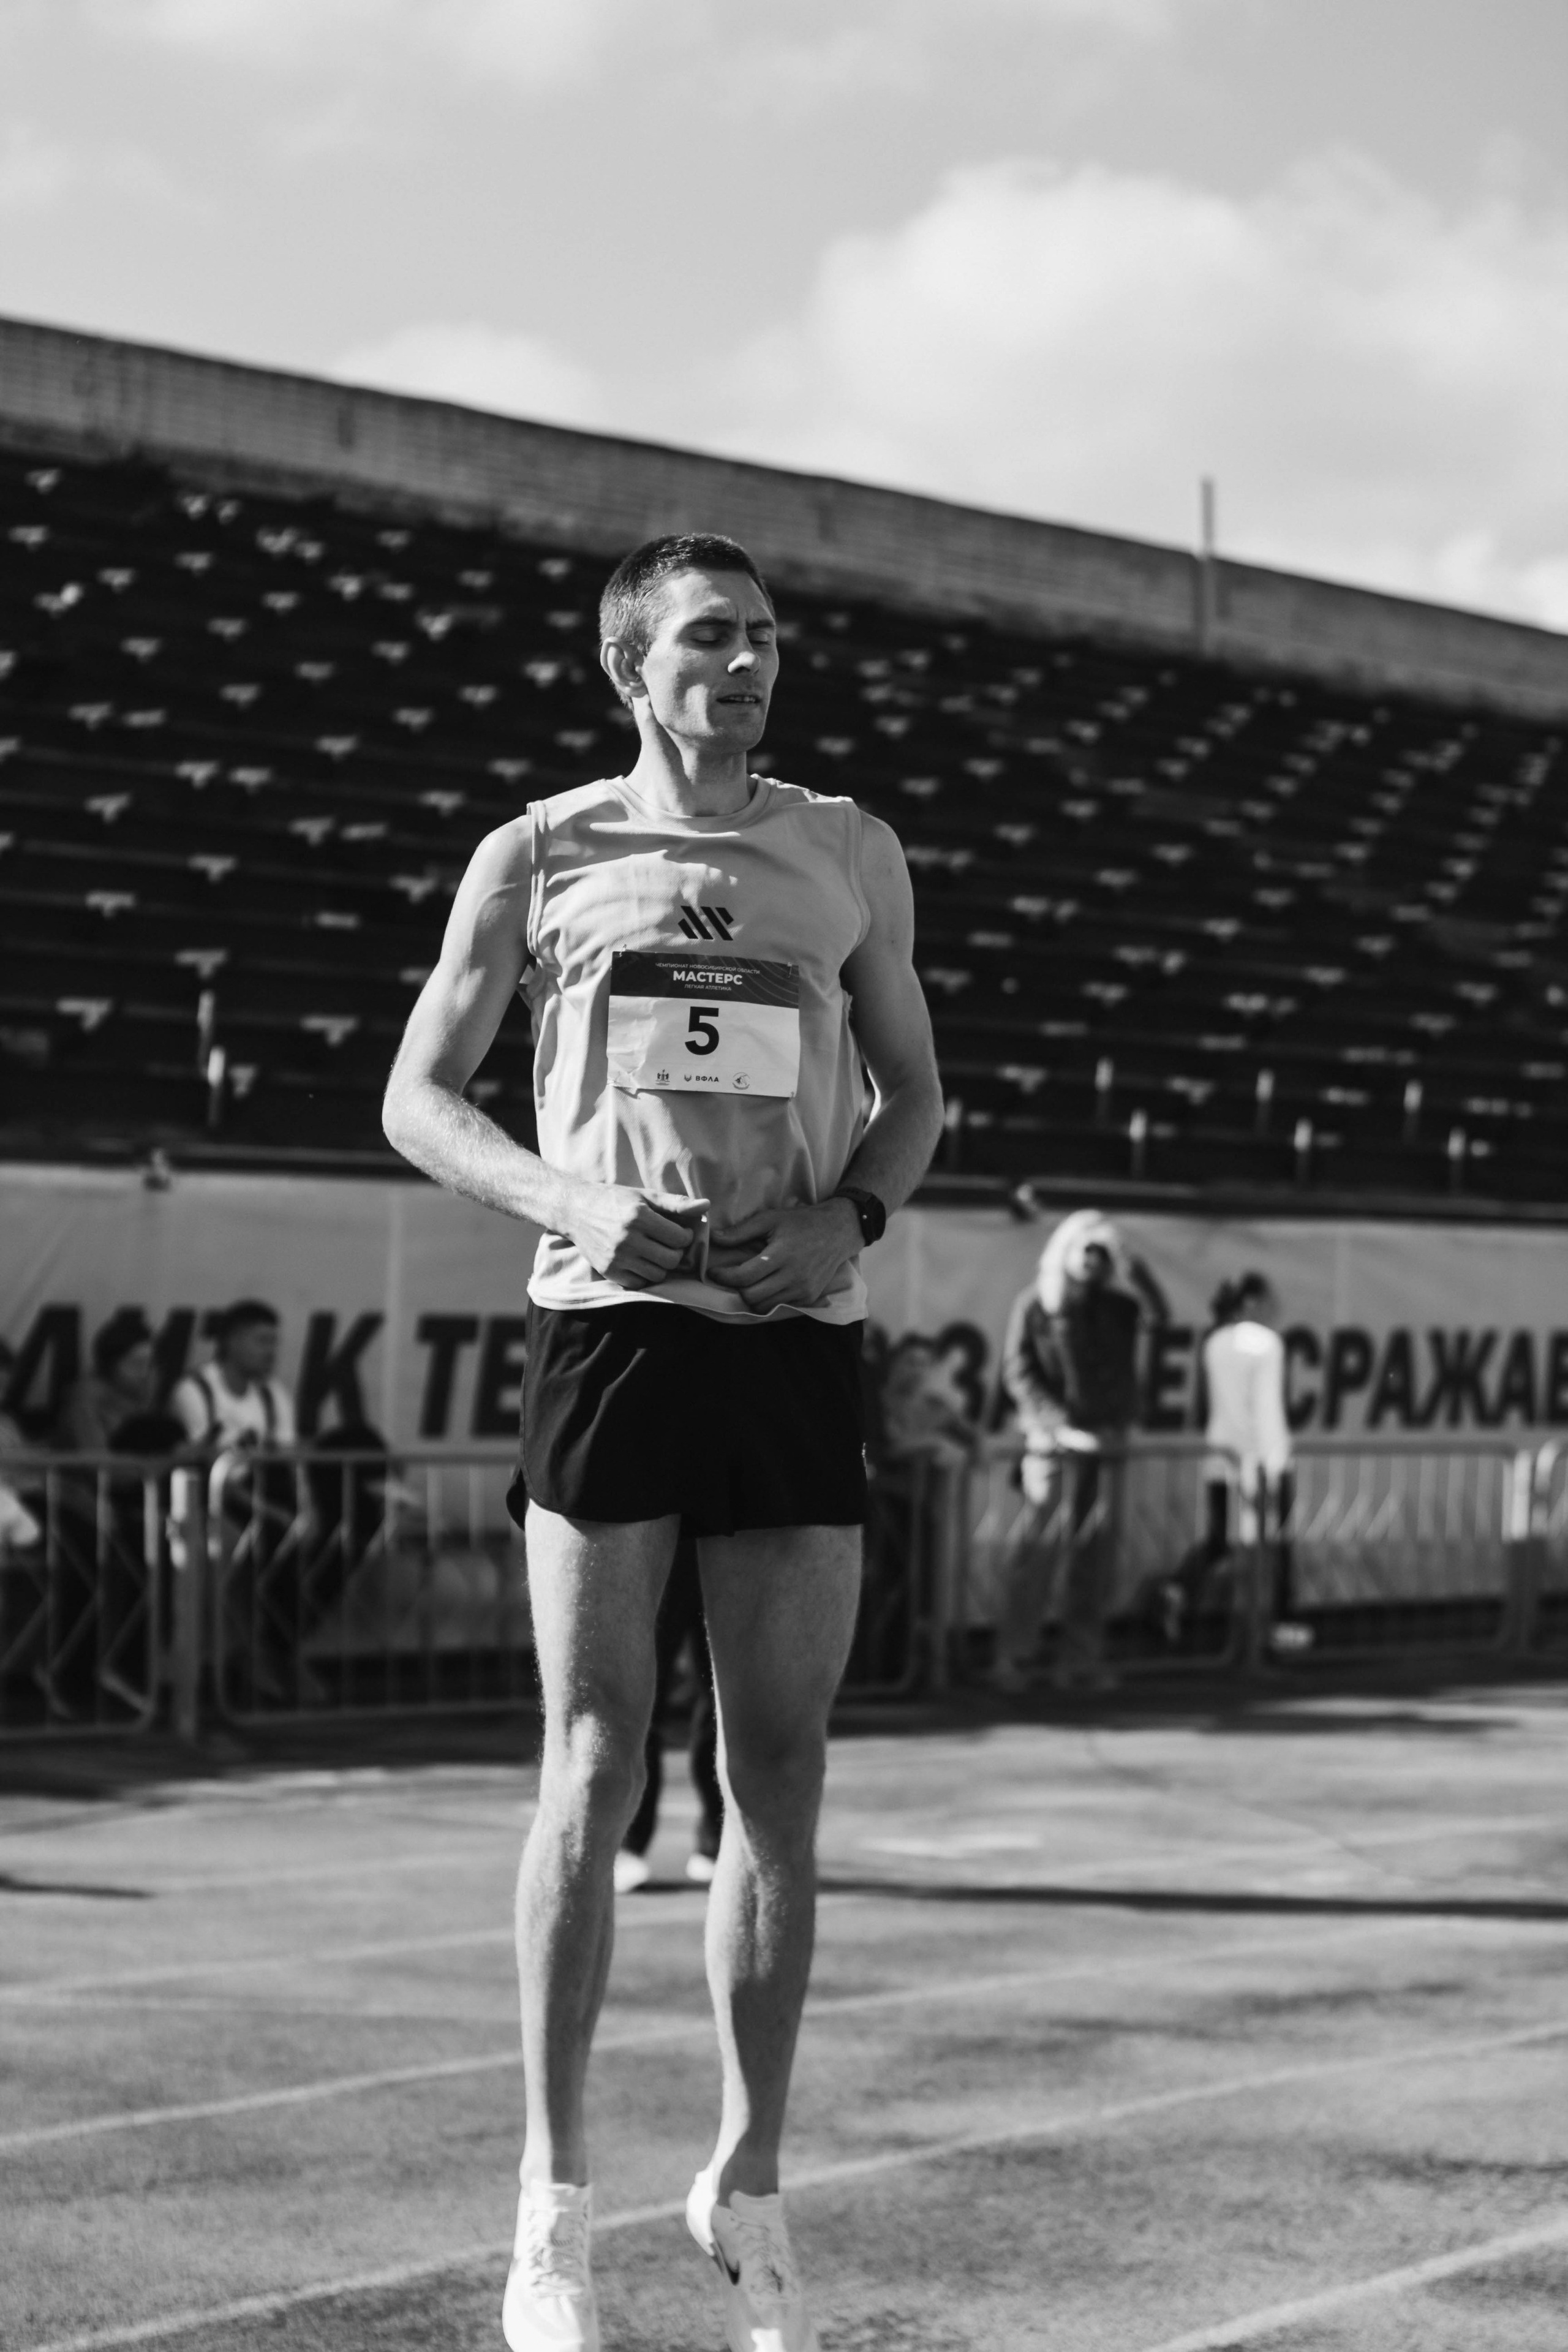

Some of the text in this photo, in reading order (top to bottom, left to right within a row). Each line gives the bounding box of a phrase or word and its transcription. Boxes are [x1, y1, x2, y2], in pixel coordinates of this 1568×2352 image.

[673, 970, 743, 985] МАСТЕРС
[685, 1006, 720, 1055] 5
[415, 1312, 528, 1438] ТЕ
